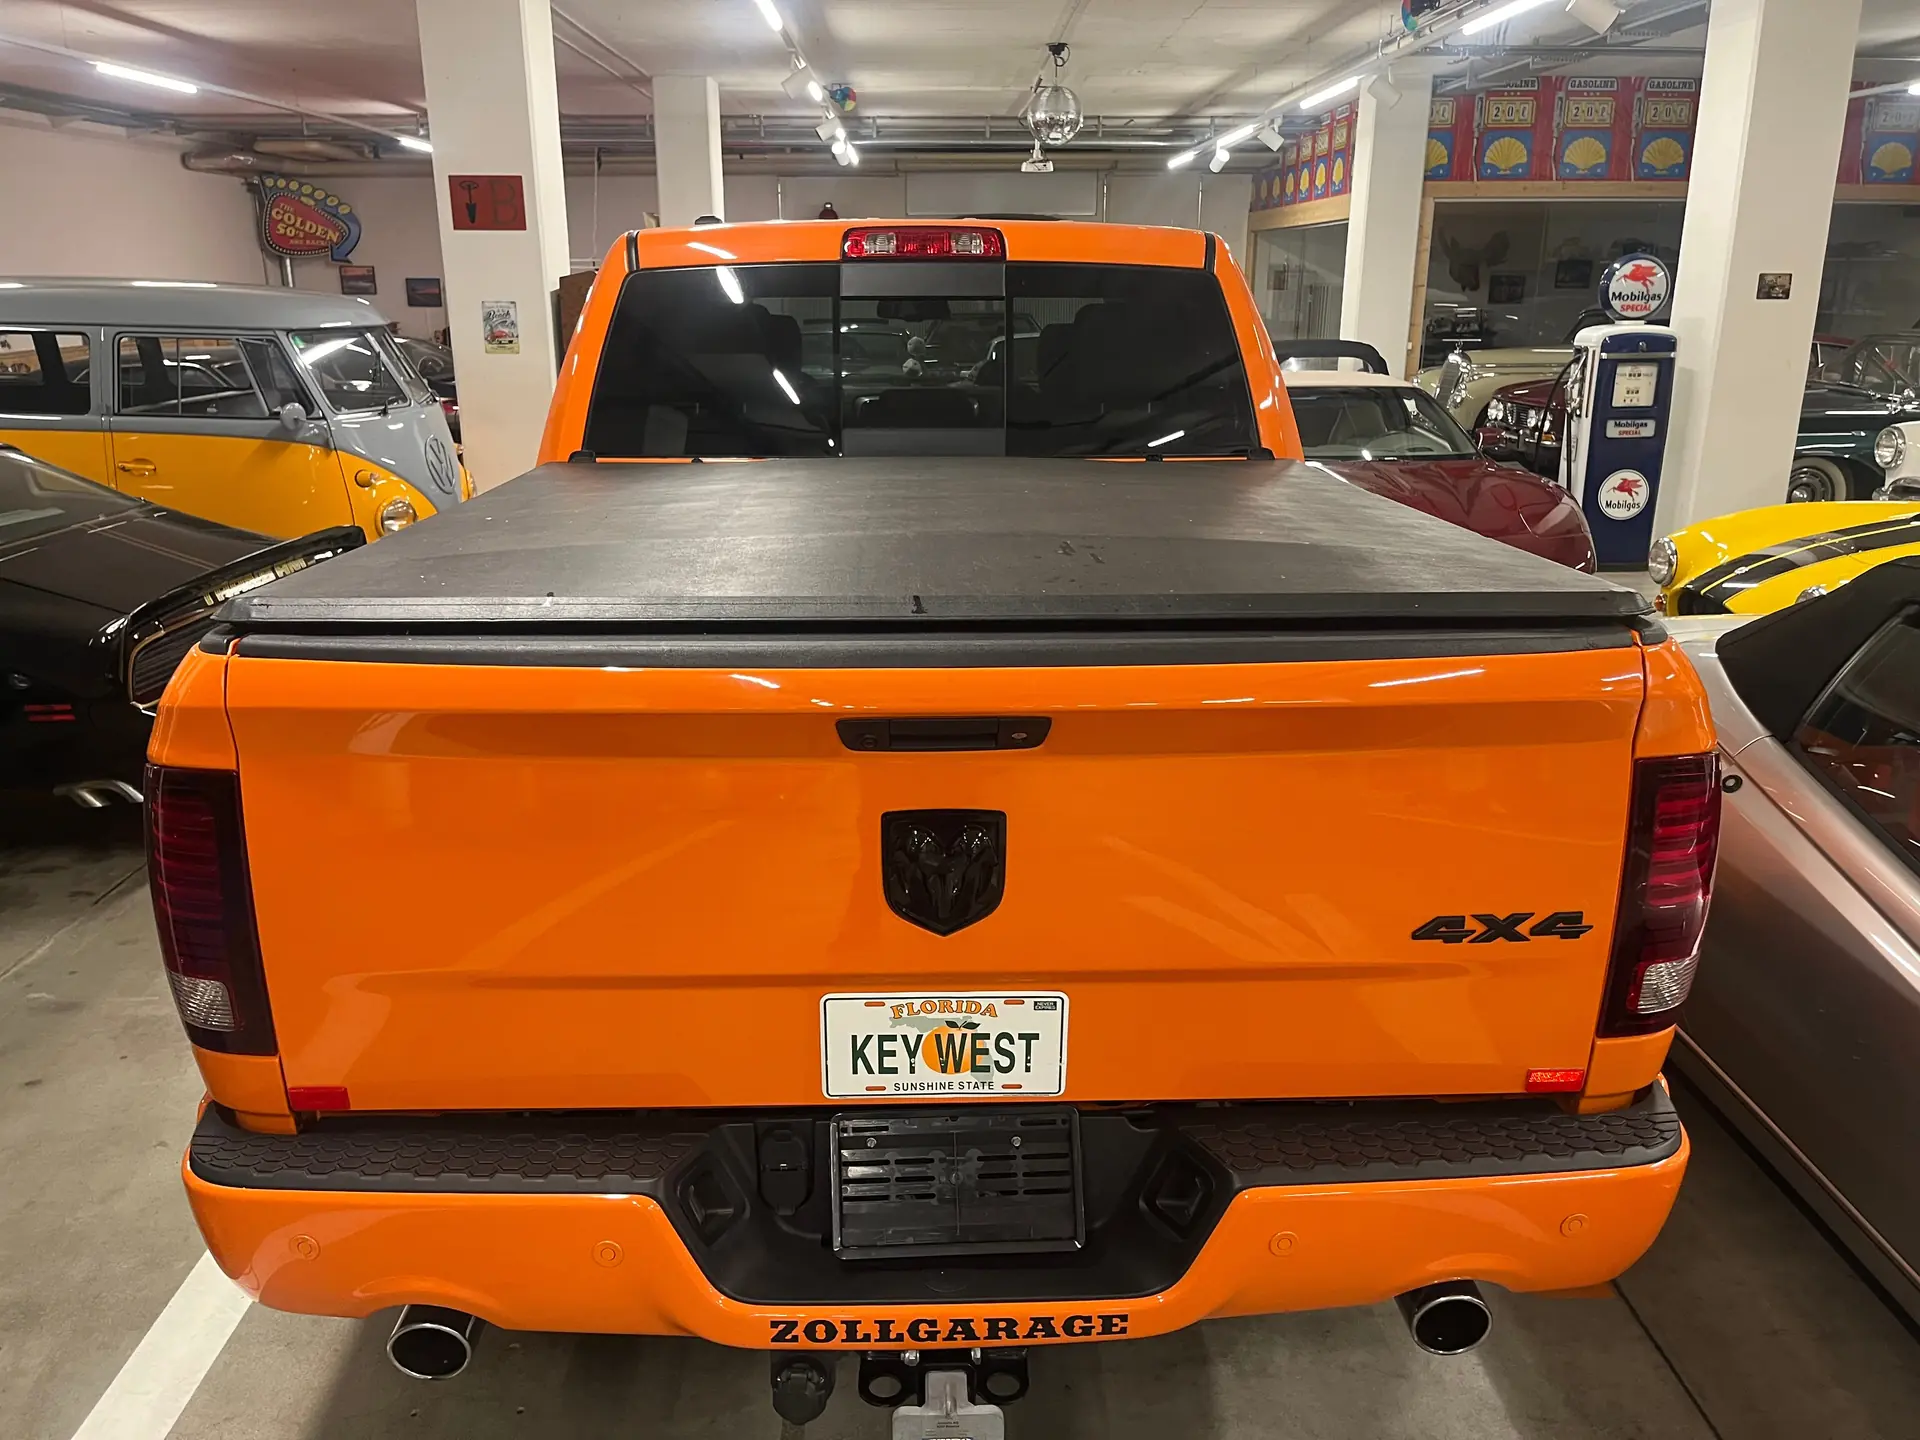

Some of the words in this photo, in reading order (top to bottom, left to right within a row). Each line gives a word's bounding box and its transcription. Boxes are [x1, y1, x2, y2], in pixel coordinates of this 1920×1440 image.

[1570, 80, 1616, 88] GASOLINE
[1649, 81, 1694, 89] GASOLINE
[271, 207, 340, 244] GOLDEN
[1611, 291, 1662, 304] Mobilgas
[1620, 304, 1652, 312] SPECIAL
[1614, 421, 1648, 429] Mobilgas
[1605, 500, 1641, 512] Mobilgas
[890, 1000, 998, 1019] FLORIDA
[851, 1034, 923, 1075] KEY
[934, 1032, 1040, 1074] WEST
[893, 1082, 954, 1092] SUNSHINE
[958, 1081, 995, 1091] STATE
[769, 1313, 1129, 1343] ZOLLGARAGE
